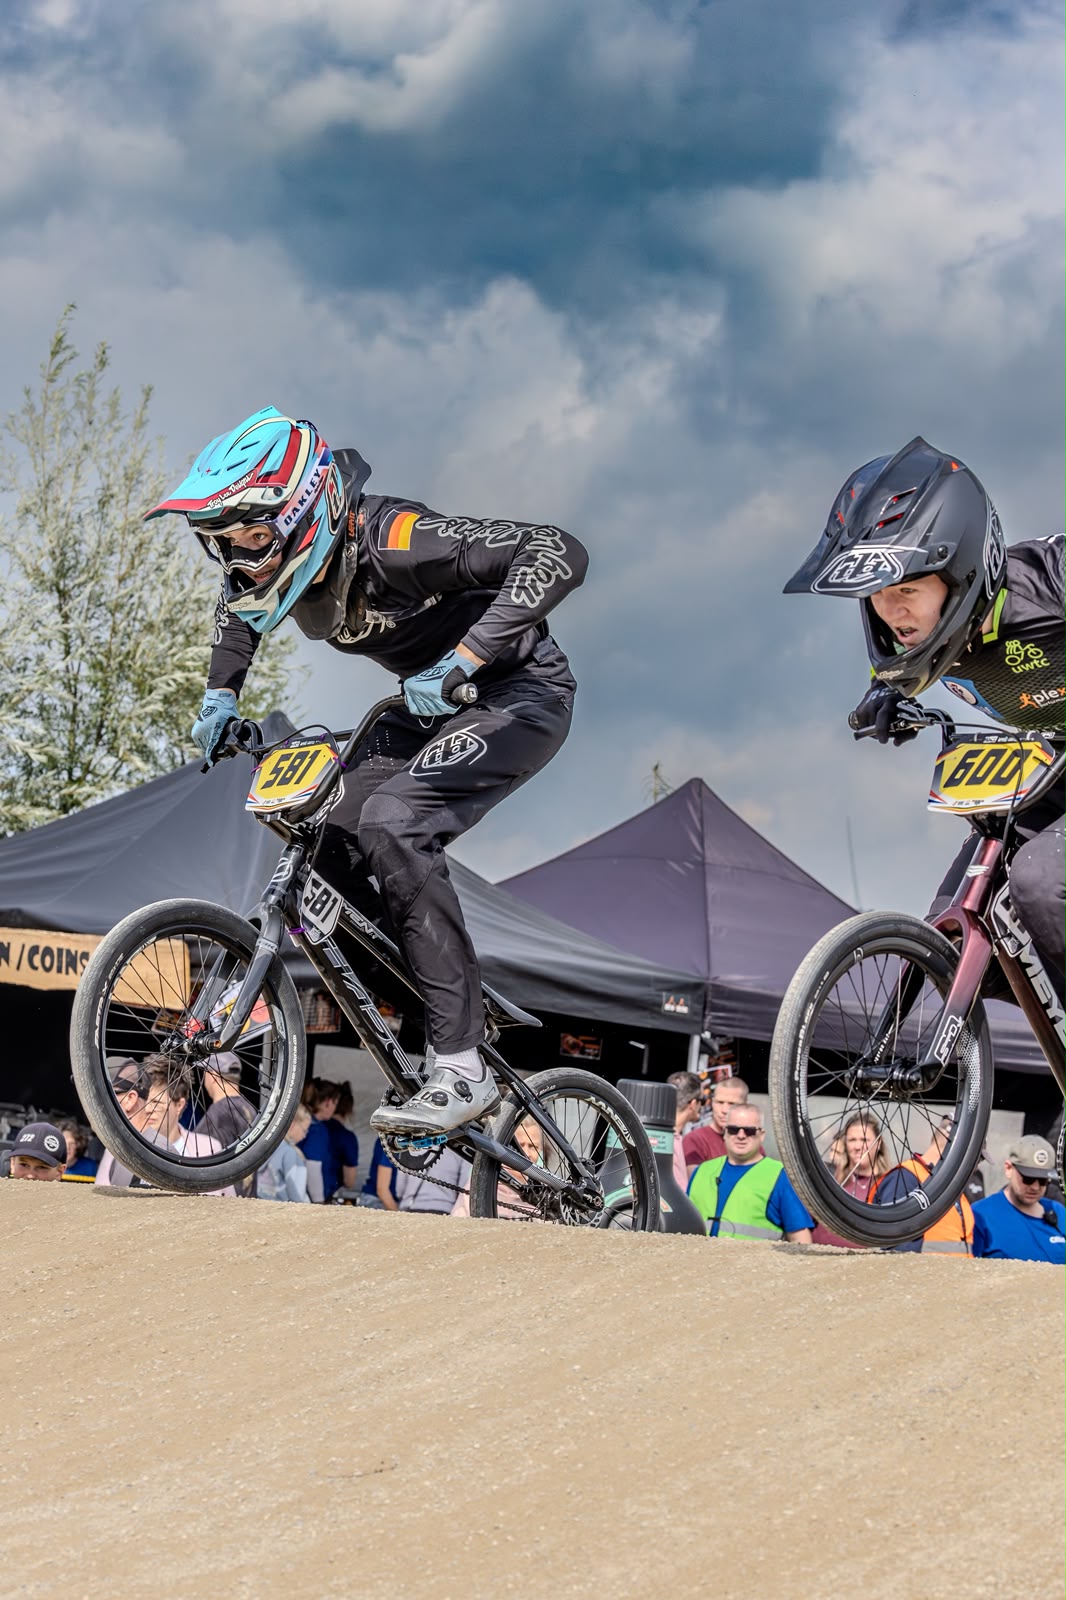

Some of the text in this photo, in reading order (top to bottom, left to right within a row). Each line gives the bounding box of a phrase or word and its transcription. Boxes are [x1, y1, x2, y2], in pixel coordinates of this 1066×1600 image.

[283, 468, 322, 527] OAKLEY
[1012, 657, 1051, 674] uwtc
[1032, 687, 1066, 707] plex
[260, 750, 322, 790] 581
[943, 748, 1032, 787] 600
[303, 877, 338, 924] 581
